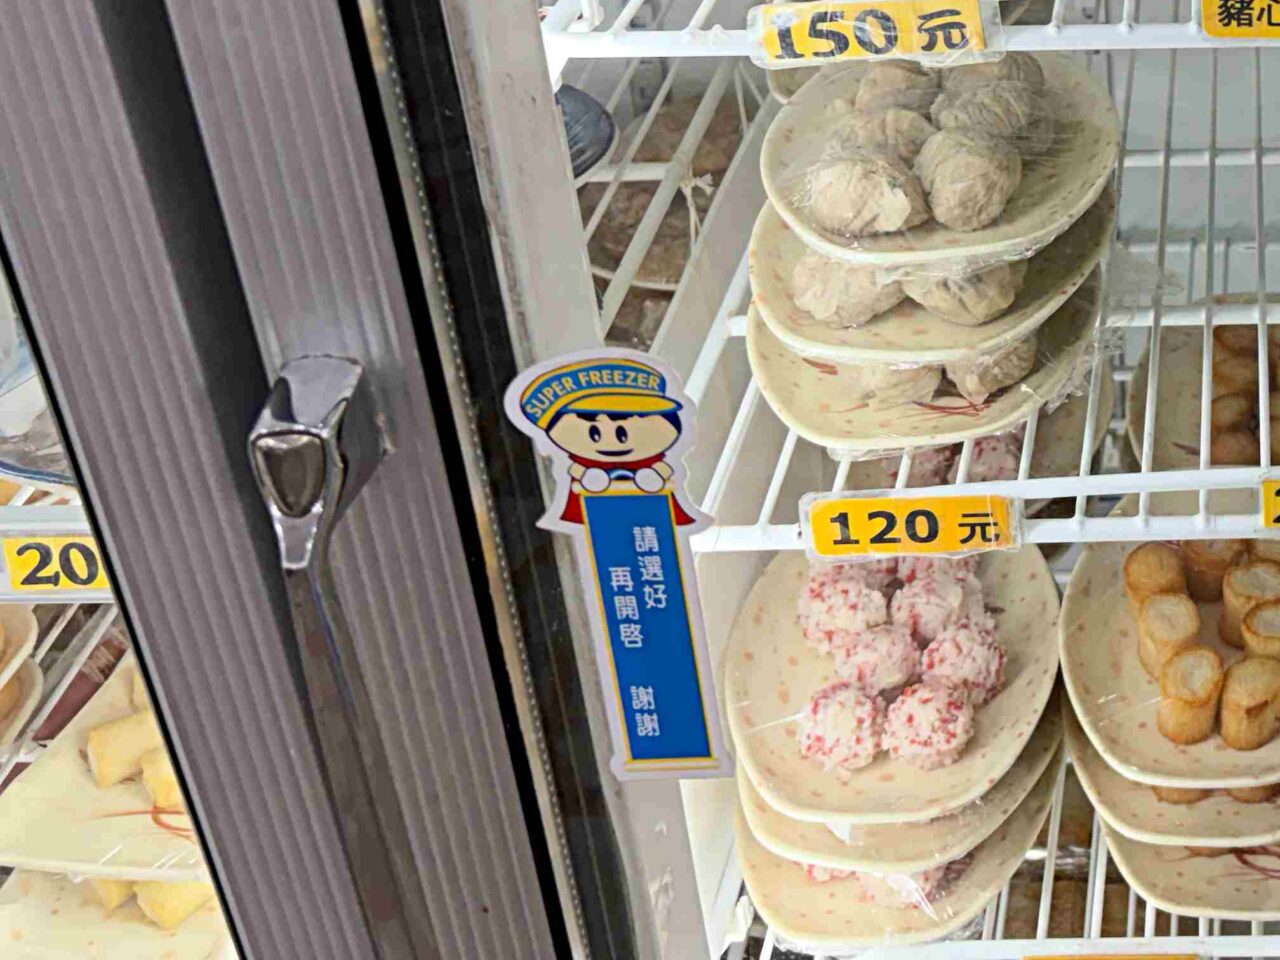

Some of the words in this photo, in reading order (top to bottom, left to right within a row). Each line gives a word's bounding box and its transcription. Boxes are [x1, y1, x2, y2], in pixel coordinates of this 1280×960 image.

[525, 376, 578, 418] SUPER
[577, 369, 661, 391] FREEZER
[632, 526, 668, 609] 請選好
[630, 685, 661, 738] 謝謝
